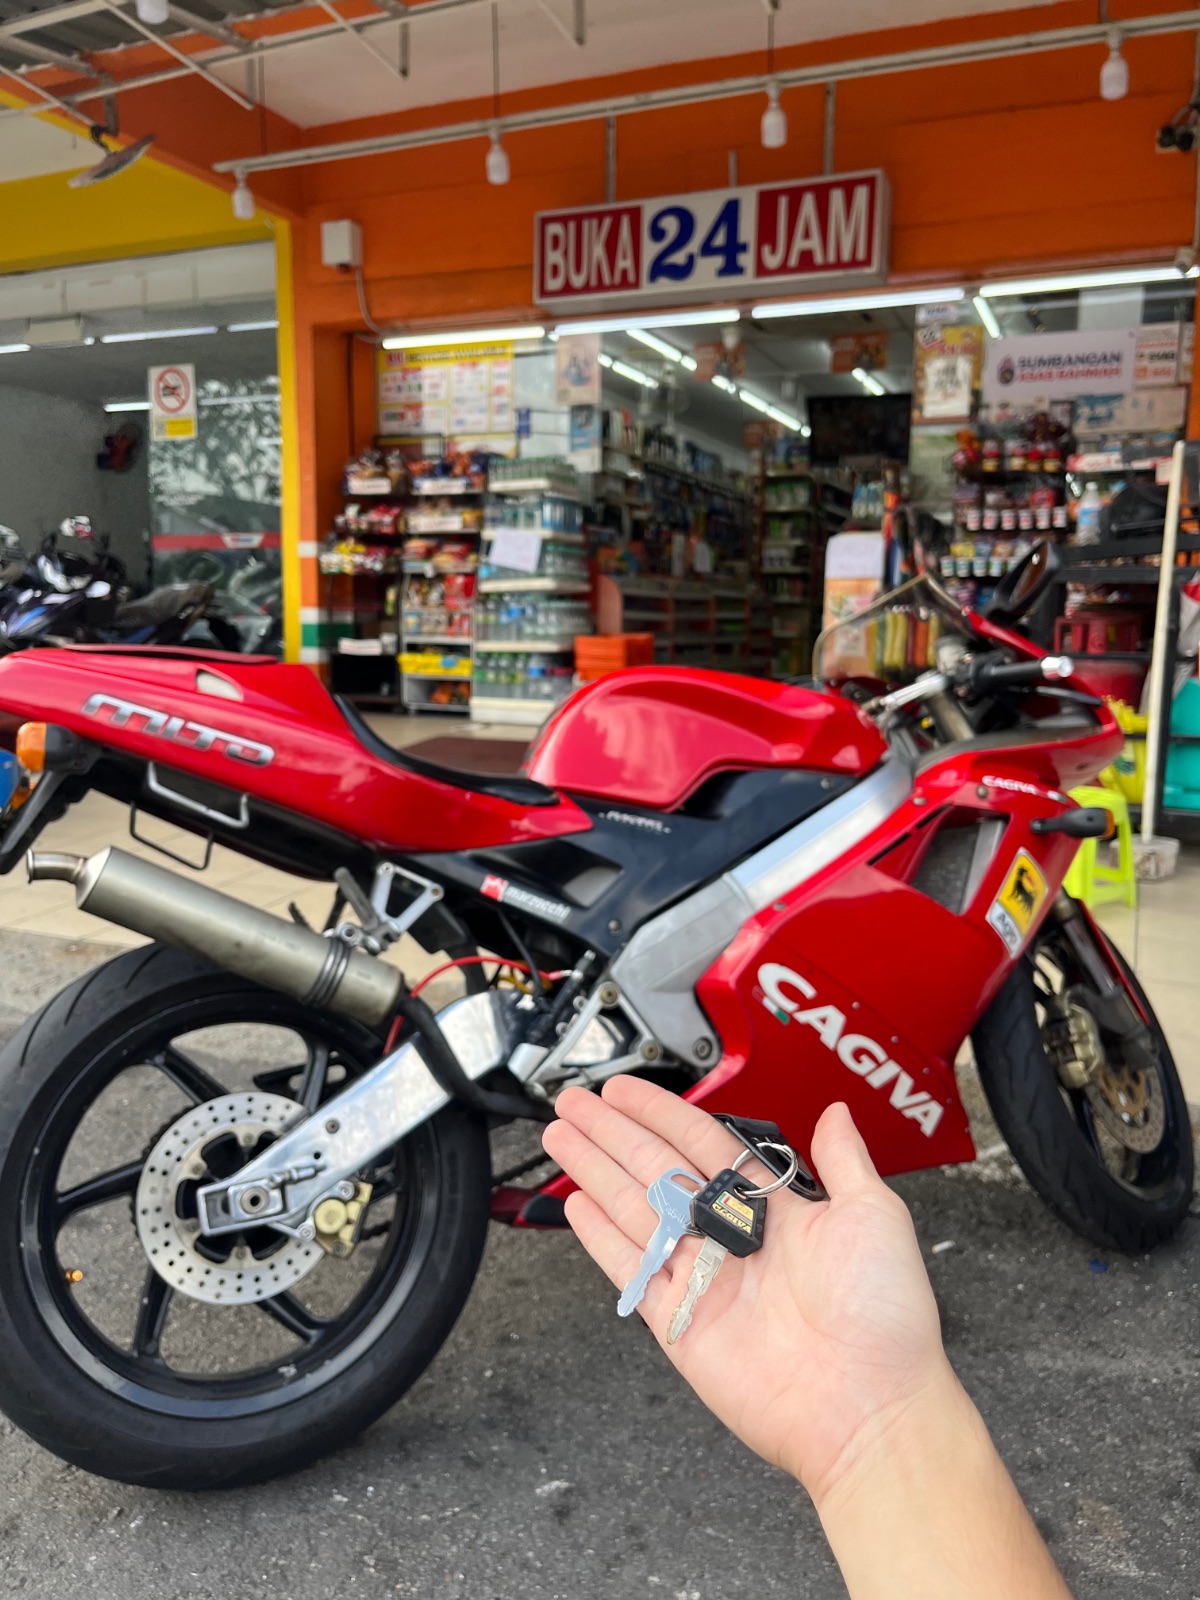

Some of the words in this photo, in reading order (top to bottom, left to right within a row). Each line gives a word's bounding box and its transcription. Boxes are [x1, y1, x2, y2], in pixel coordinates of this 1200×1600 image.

[544, 213, 637, 293] BUKA
[648, 197, 748, 284] 24
[760, 184, 871, 270] JAM
[1018, 351, 1122, 369] SUMBANGAN
[982, 775, 1037, 796] CAGIVA
[756, 962, 945, 1138] CAGIVA
